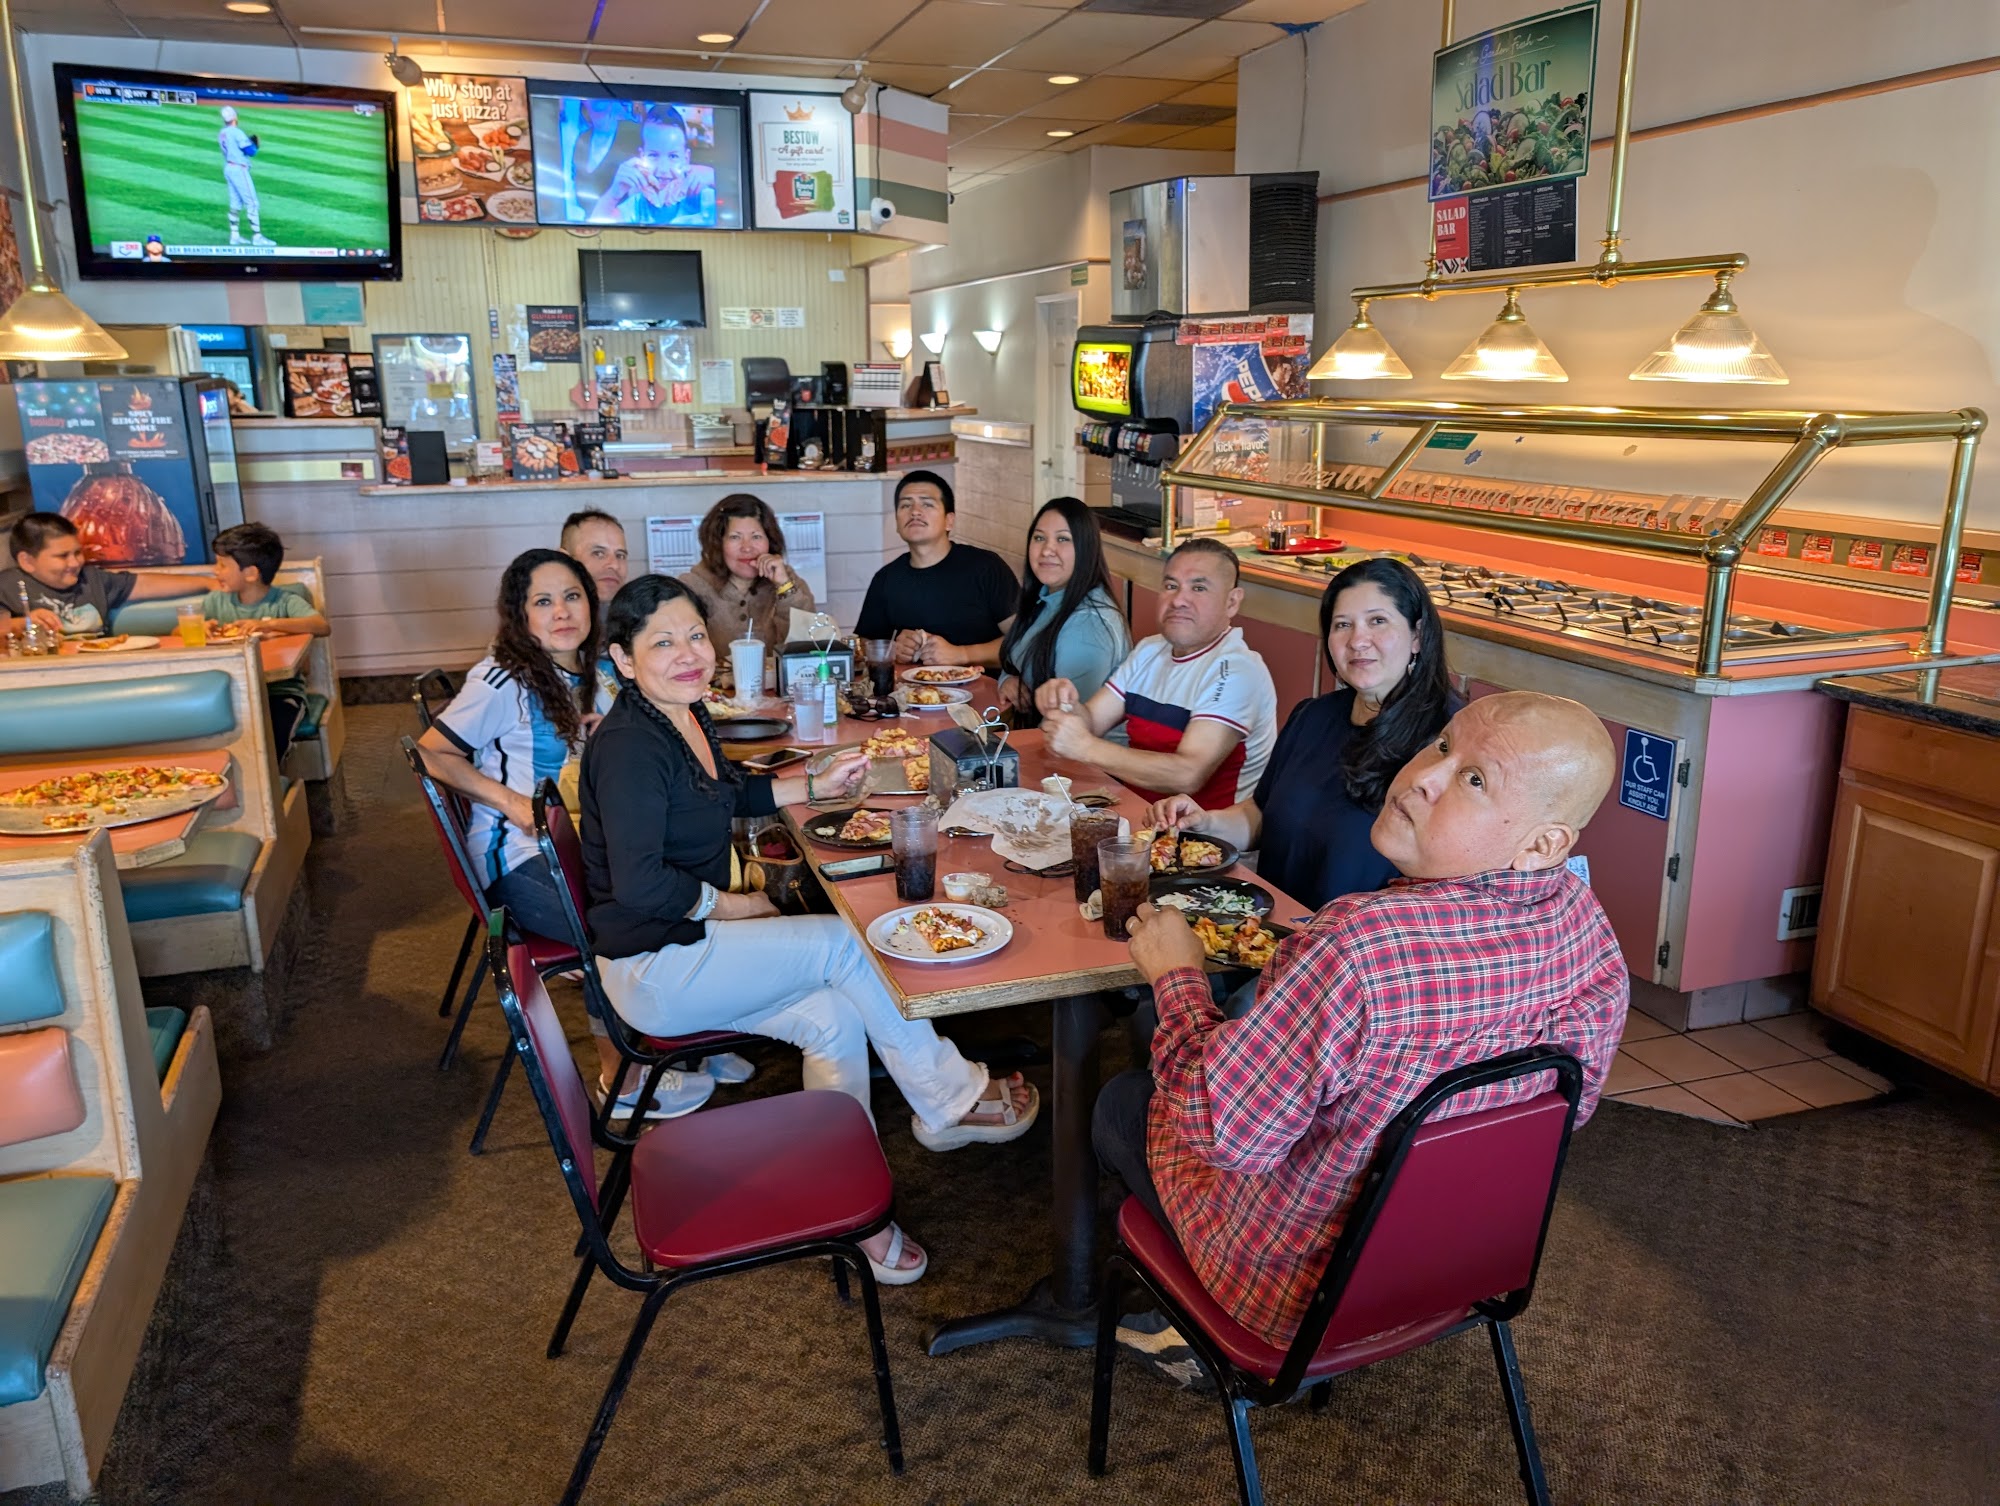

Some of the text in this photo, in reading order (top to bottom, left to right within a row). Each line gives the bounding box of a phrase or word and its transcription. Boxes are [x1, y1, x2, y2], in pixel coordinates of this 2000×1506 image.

[1511, 34, 1534, 55] Fresh
[423, 77, 512, 103] Why stop at
[1455, 60, 1551, 113] Salad Bar
[431, 99, 508, 123] just pizza?
[783, 130, 820, 145] BESTOW
[1436, 206, 1467, 222] SALAD
[1437, 222, 1456, 236] BAR
[27, 408, 47, 417] Great
[66, 418, 80, 429] gift
[80, 418, 96, 427] idea
[151, 417, 173, 425] FIRE
[1216, 441, 1234, 453] kick
[1582, 489, 1655, 525] Pizza
[1625, 780, 1666, 799] OUR STAFF CAN
[1628, 789, 1647, 801] ASSIST
[1628, 797, 1647, 808] KINDLY
